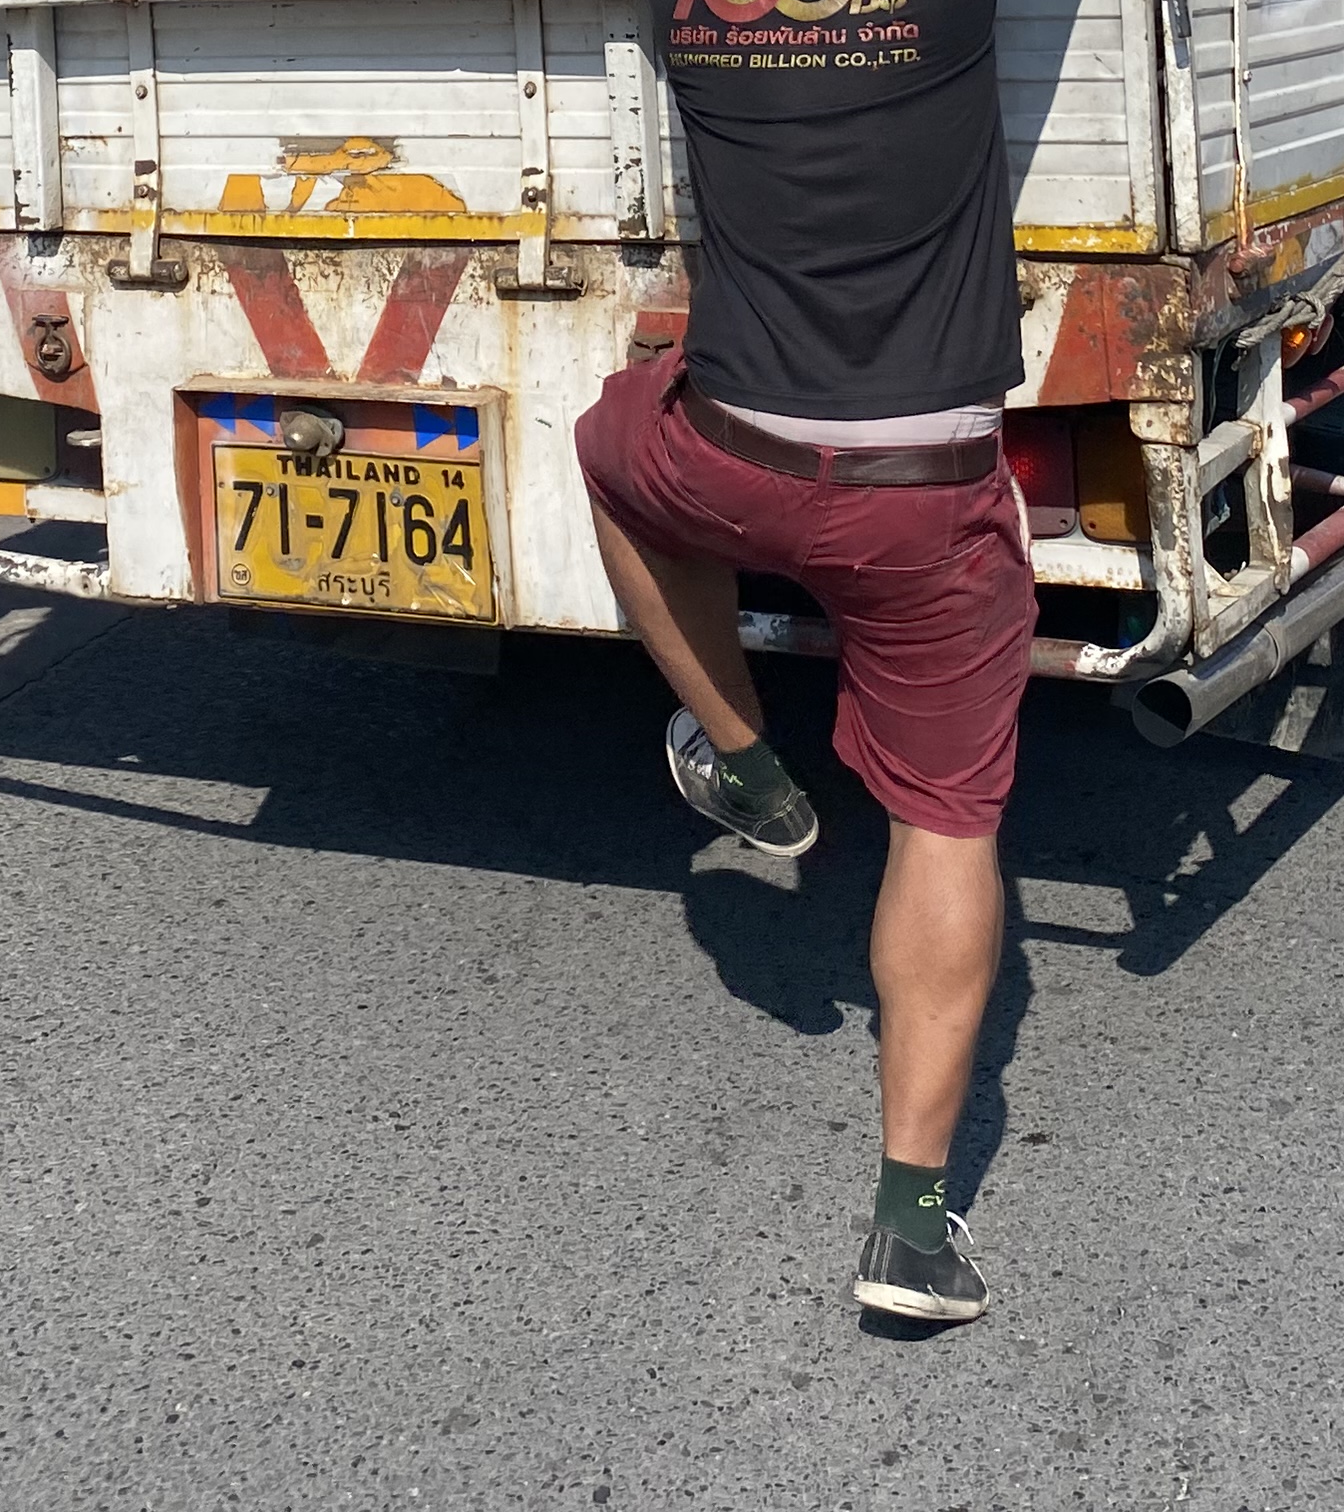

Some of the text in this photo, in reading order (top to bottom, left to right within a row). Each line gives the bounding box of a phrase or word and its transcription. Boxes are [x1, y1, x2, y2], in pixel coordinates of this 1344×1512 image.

[670, 20, 920, 46] บริษัท ร้อยพันล้าน จำกัด
[749, 53, 827, 69] BILLION
[276, 454, 466, 490] THAILAND 14
[232, 480, 475, 571] 71-7164
